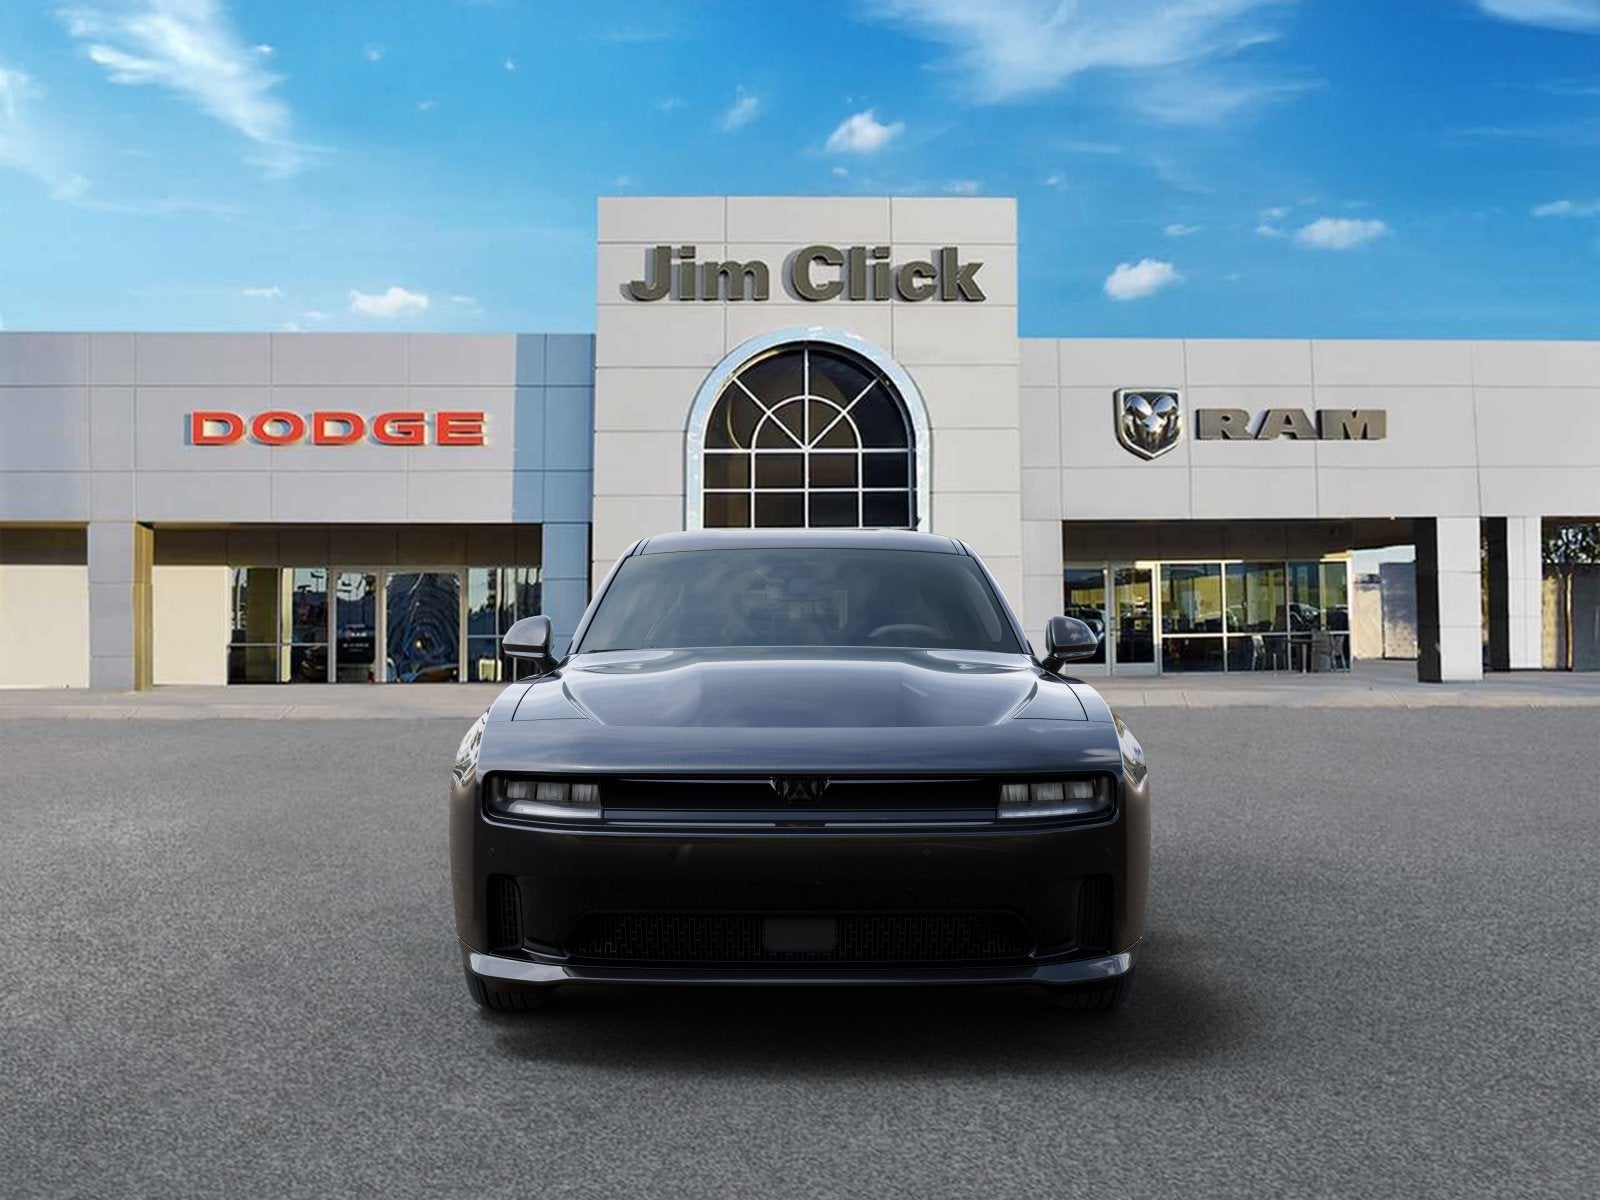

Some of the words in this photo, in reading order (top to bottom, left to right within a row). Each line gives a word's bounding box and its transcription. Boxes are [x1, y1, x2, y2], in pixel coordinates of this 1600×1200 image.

[626, 244, 770, 302] Jim
[789, 244, 986, 302] Click
[190, 410, 486, 446] DODGE
[1196, 408, 1387, 440] RAM
